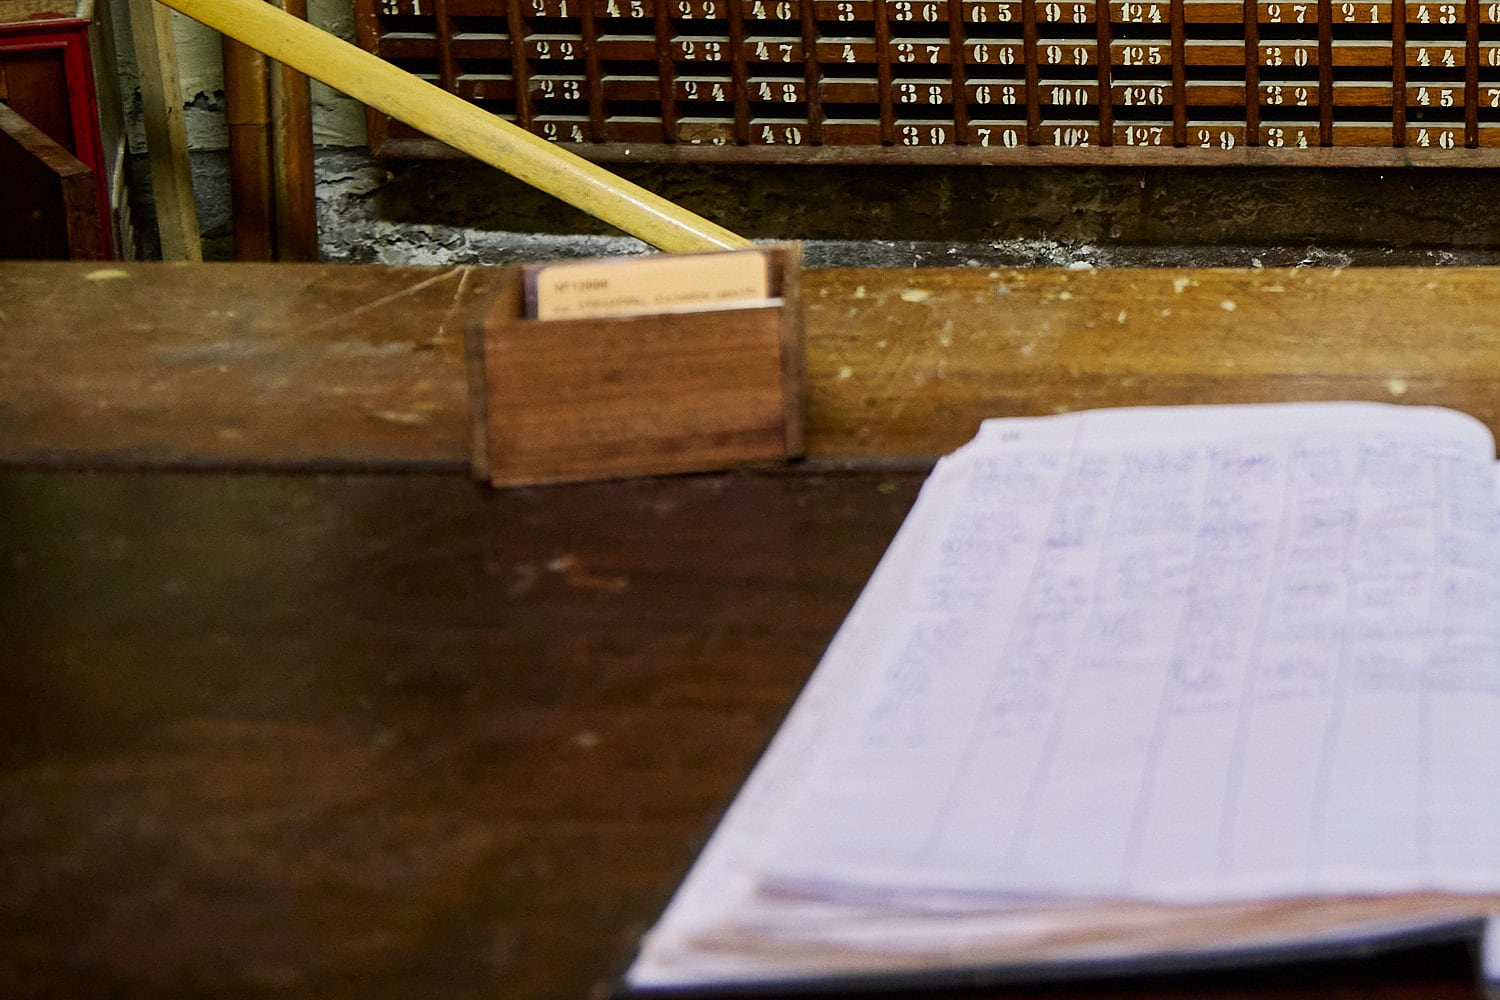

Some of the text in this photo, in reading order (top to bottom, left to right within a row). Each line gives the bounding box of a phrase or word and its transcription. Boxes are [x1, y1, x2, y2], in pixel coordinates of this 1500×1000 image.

[838, 4, 854, 21] 3
[1121, 2, 1161, 23] 124
[843, 45, 855, 62] 4
[1052, 87, 1087, 105] 100
[1124, 88, 1163, 105] 126
[1053, 128, 1089, 147] 102
[1125, 127, 1162, 146] 127
